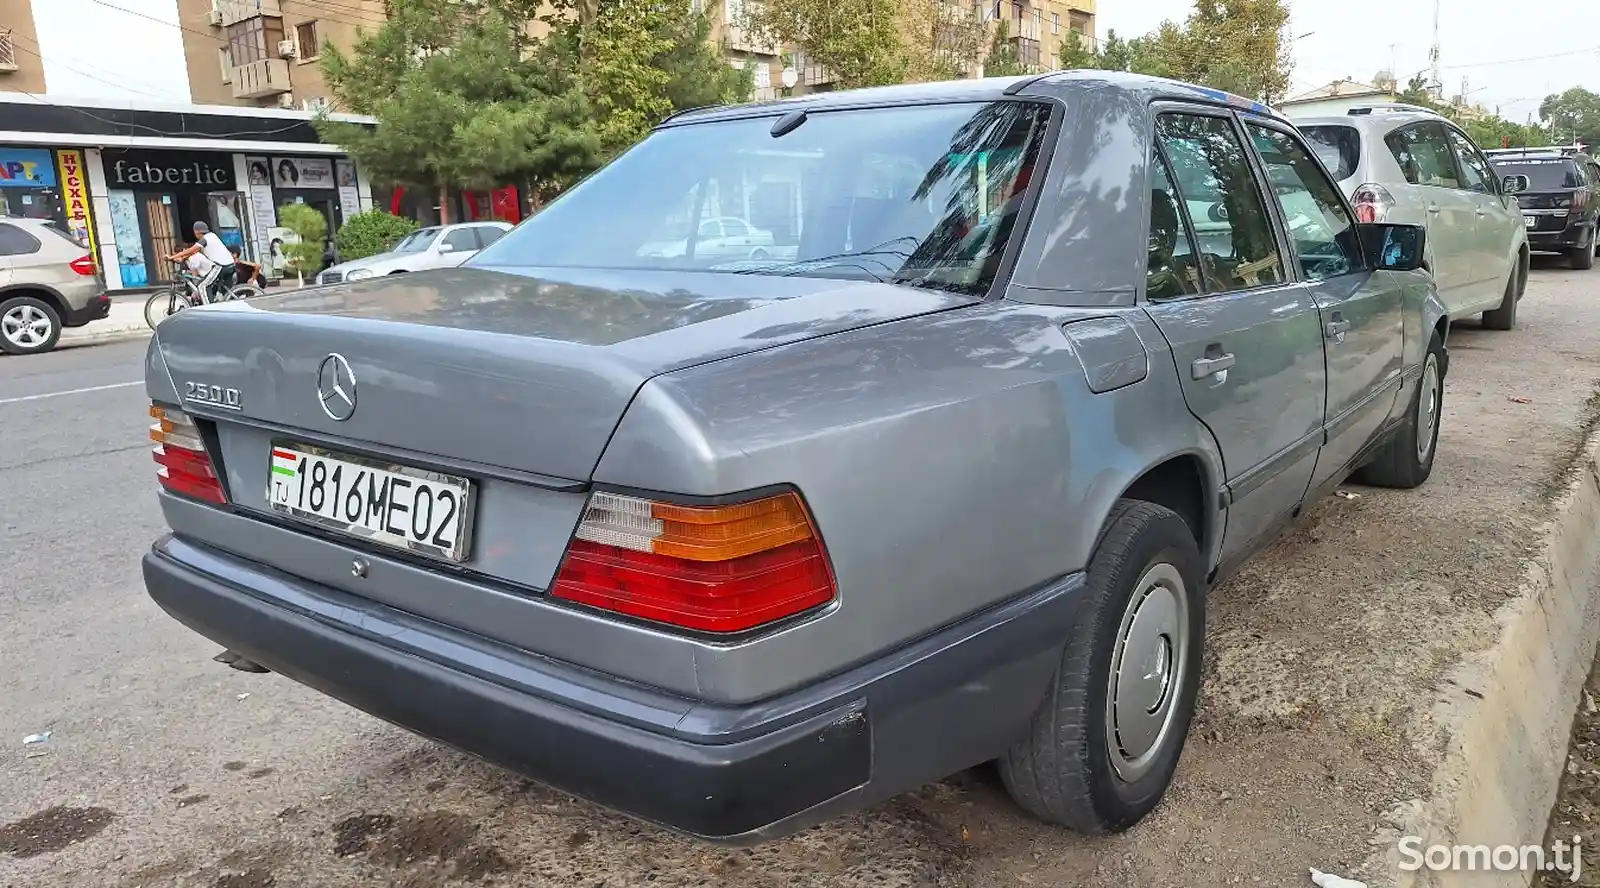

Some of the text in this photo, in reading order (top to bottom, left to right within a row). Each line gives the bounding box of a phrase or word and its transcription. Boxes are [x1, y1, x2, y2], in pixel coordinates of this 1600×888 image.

[113, 160, 228, 184] faberlic
[275, 482, 289, 503] TJ
[297, 457, 458, 549] 1816ME02
